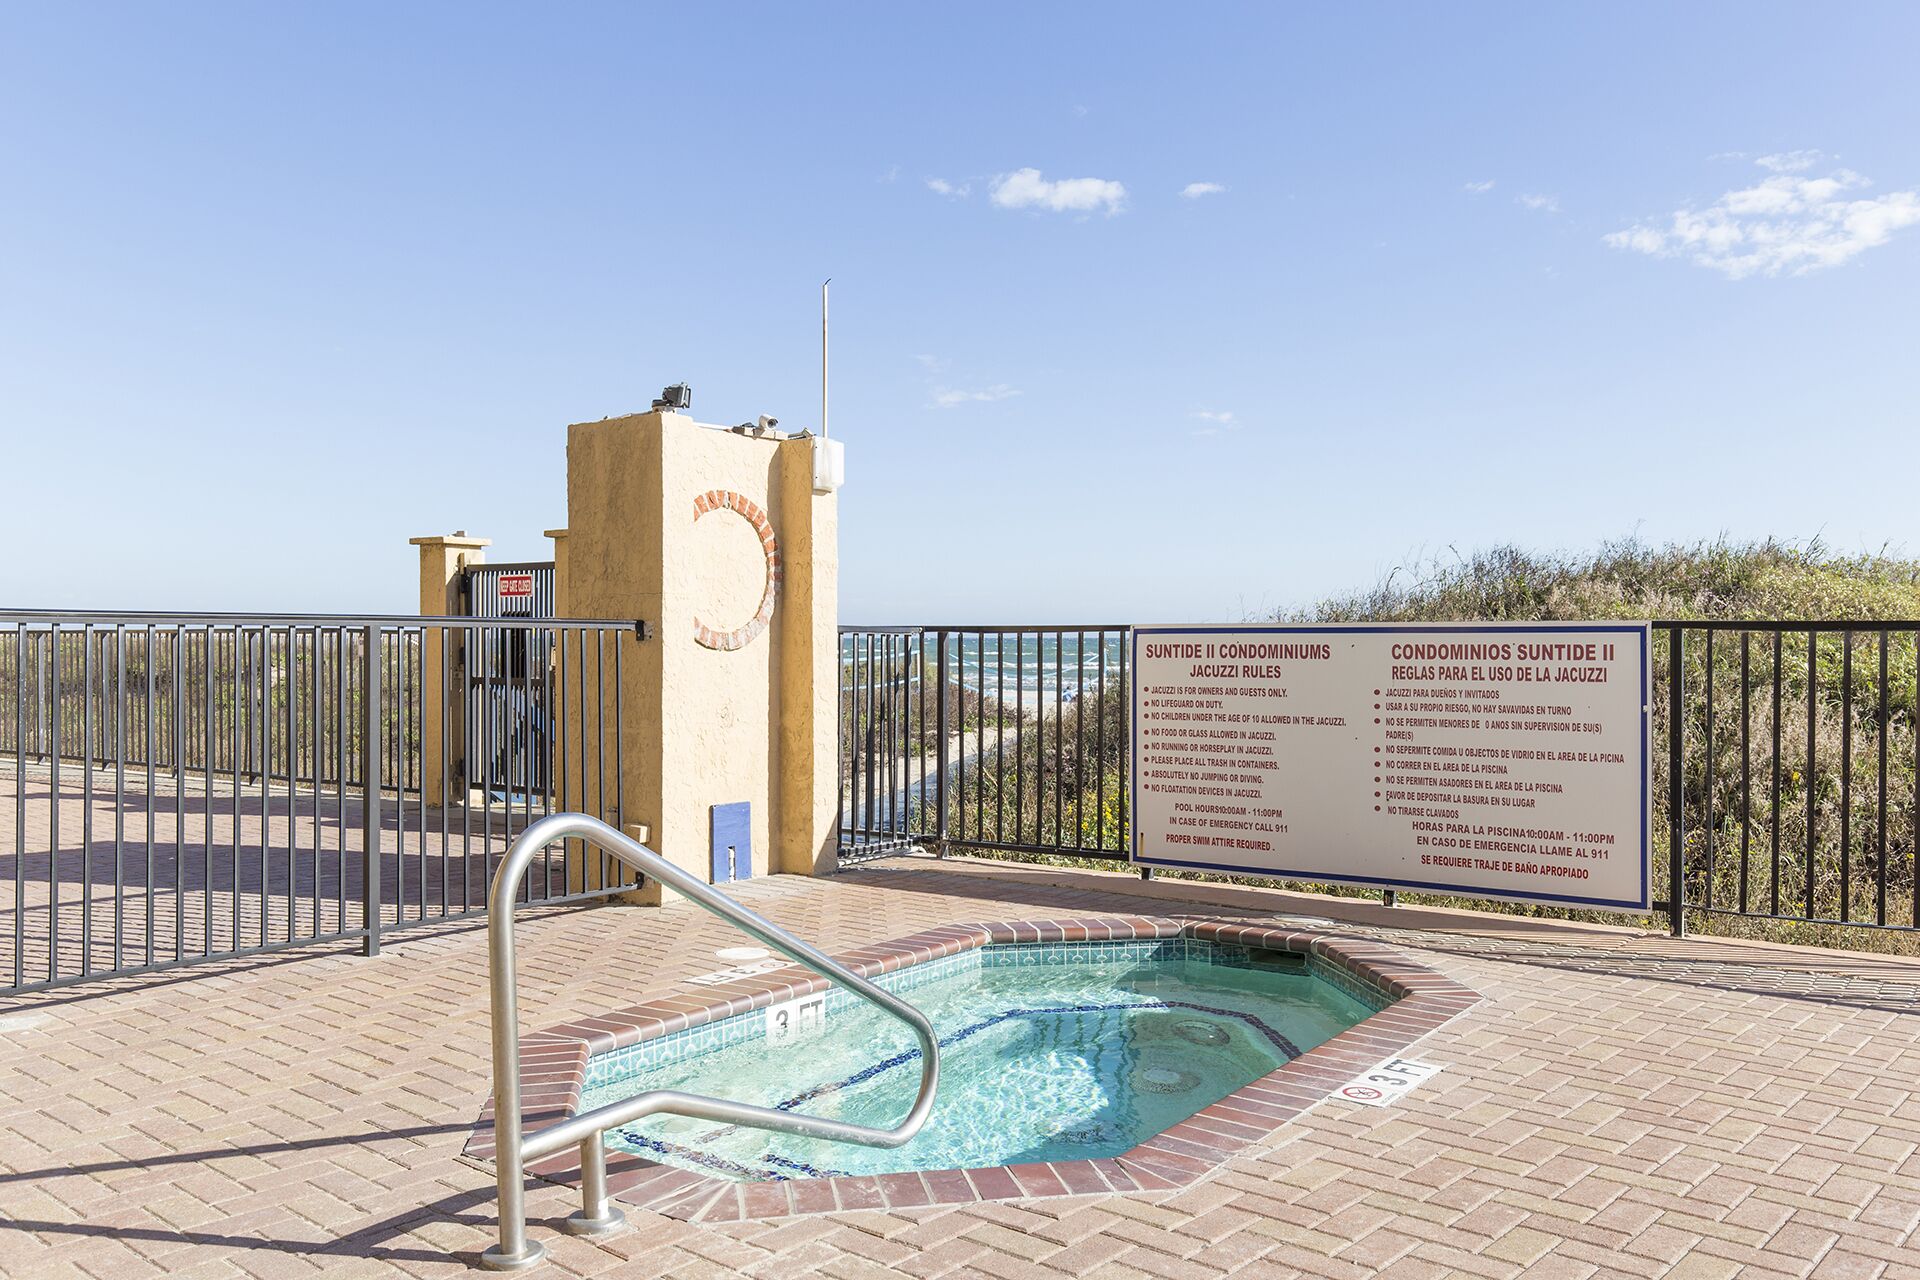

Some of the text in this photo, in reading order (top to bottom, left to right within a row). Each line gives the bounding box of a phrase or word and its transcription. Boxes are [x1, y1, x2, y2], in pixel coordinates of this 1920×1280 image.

[1146, 644, 1330, 659] SUNTIDE II CONDOMINIUMS
[1391, 644, 1614, 661] CONDOMINIOS SUNTIDE II
[1190, 665, 1281, 678] JACUZZI RULES
[1391, 666, 1607, 683] REGLAS PARA EL USO DE LA JACUZZI
[1151, 687, 1175, 695] JACUZZI
[1176, 687, 1183, 695] IS
[1184, 687, 1196, 695] FOR
[1197, 687, 1223, 696] OWNERS
[1224, 688, 1238, 696] AND
[1239, 688, 1266, 697] GUESTS
[1385, 688, 1499, 699] JACUZZI PARA DUEÑOS Y INVITADOS
[1150, 700, 1160, 708] NO
[1160, 700, 1194, 708] LIFEGUARD
[1195, 700, 1204, 708] ON
[1385, 703, 1402, 711] USAR
[1403, 703, 1408, 712] A
[1409, 703, 1418, 712] SU
[1419, 703, 1443, 712] PROPIO
[1471, 704, 1481, 713] NO
[1482, 705, 1496, 713] HAY
[1497, 705, 1534, 714] SAVAVIDAS
[1535, 706, 1546, 715] EN
[1547, 706, 1571, 715] TURNO
[1151, 712, 1160, 720] NO
[1161, 713, 1191, 721] CHILDREN
[1191, 714, 1213, 722] UNDER
[1214, 714, 1226, 723] THE
[1227, 715, 1240, 723] AGE
[1241, 715, 1250, 723] OF
[1252, 715, 1259, 724] 10
[1260, 715, 1291, 725] ALLOWED
[1292, 716, 1300, 725] IN
[1301, 717, 1315, 726] THE
[1385, 717, 1395, 727] NO
[1396, 718, 1404, 727] SE
[1405, 718, 1437, 728] PERMITEN
[1438, 719, 1469, 729] MENORES
[1471, 720, 1480, 730] DE
[1511, 721, 1522, 731] SIN
[1524, 721, 1570, 733] SUPERVISION
[1571, 722, 1581, 733] DE
[1582, 723, 1602, 734] SU(S)
[1151, 728, 1160, 736] NO
[1161, 729, 1177, 737] FOOD
[1178, 729, 1187, 737] OR
[1188, 729, 1208, 738] GLASS
[1209, 730, 1238, 739] ALLOWED
[1239, 731, 1246, 739] IN
[1385, 731, 1413, 741] PADRE(S)
[1151, 743, 1160, 751] NO
[1161, 743, 1188, 752] RUNNING
[1189, 744, 1198, 752] OR
[1199, 744, 1235, 753] HORSEPLAY
[1236, 745, 1244, 754] IN
[1385, 746, 1395, 754] NO
[1432, 747, 1457, 757] COMIDA
[1458, 748, 1463, 757] U
[1464, 748, 1499, 758] OBJECTOS
[1500, 749, 1509, 759] DE
[1511, 750, 1534, 760] VIDRIO
[1535, 751, 1546, 760] EN
[1547, 751, 1555, 760] EL
[1557, 751, 1576, 761] AREA
[1577, 752, 1587, 762] DE
[1588, 752, 1598, 762] LA
[1599, 753, 1624, 763] PICINA
[1150, 756, 1173, 765] PLEASE
[1174, 757, 1193, 766] PLACE
[1194, 758, 1206, 766] ALL
[1207, 758, 1227, 767] TRASH
[1228, 759, 1236, 767] IN
[1151, 771, 1188, 780] ABSOLUTELY
[1189, 772, 1199, 780] NO
[1200, 773, 1228, 782] JUMPING
[1229, 774, 1238, 782] OR
[1151, 784, 1160, 793] NO
[1160, 785, 1197, 794] FLOATATION
[1198, 787, 1224, 796] DEVICES
[1225, 788, 1232, 796] IN
[1174, 803, 1193, 812] POOL
[1252, 808, 1282, 817] 11:00PM
[1387, 806, 1459, 819] NO TIRARSE CLAVADOS
[1169, 817, 1288, 832] IN CASE OF EMERGENCY CALL 911
[1411, 821, 1443, 832] HORAS
[1445, 823, 1470, 834] PARA
[1472, 825, 1484, 835] LA
[1573, 832, 1614, 845] 11:00PM
[1165, 834, 1270, 851] PROPER SWIM ATTIRE REQUIRED
[1416, 836, 1608, 859] EN CASO DE EMERGENCIA LLAME AL 911
[1420, 855, 1588, 879] SE REQUIERE TRAJE DE BAÑO APROPIADO
[1368, 1059, 1431, 1086] 3 FT
